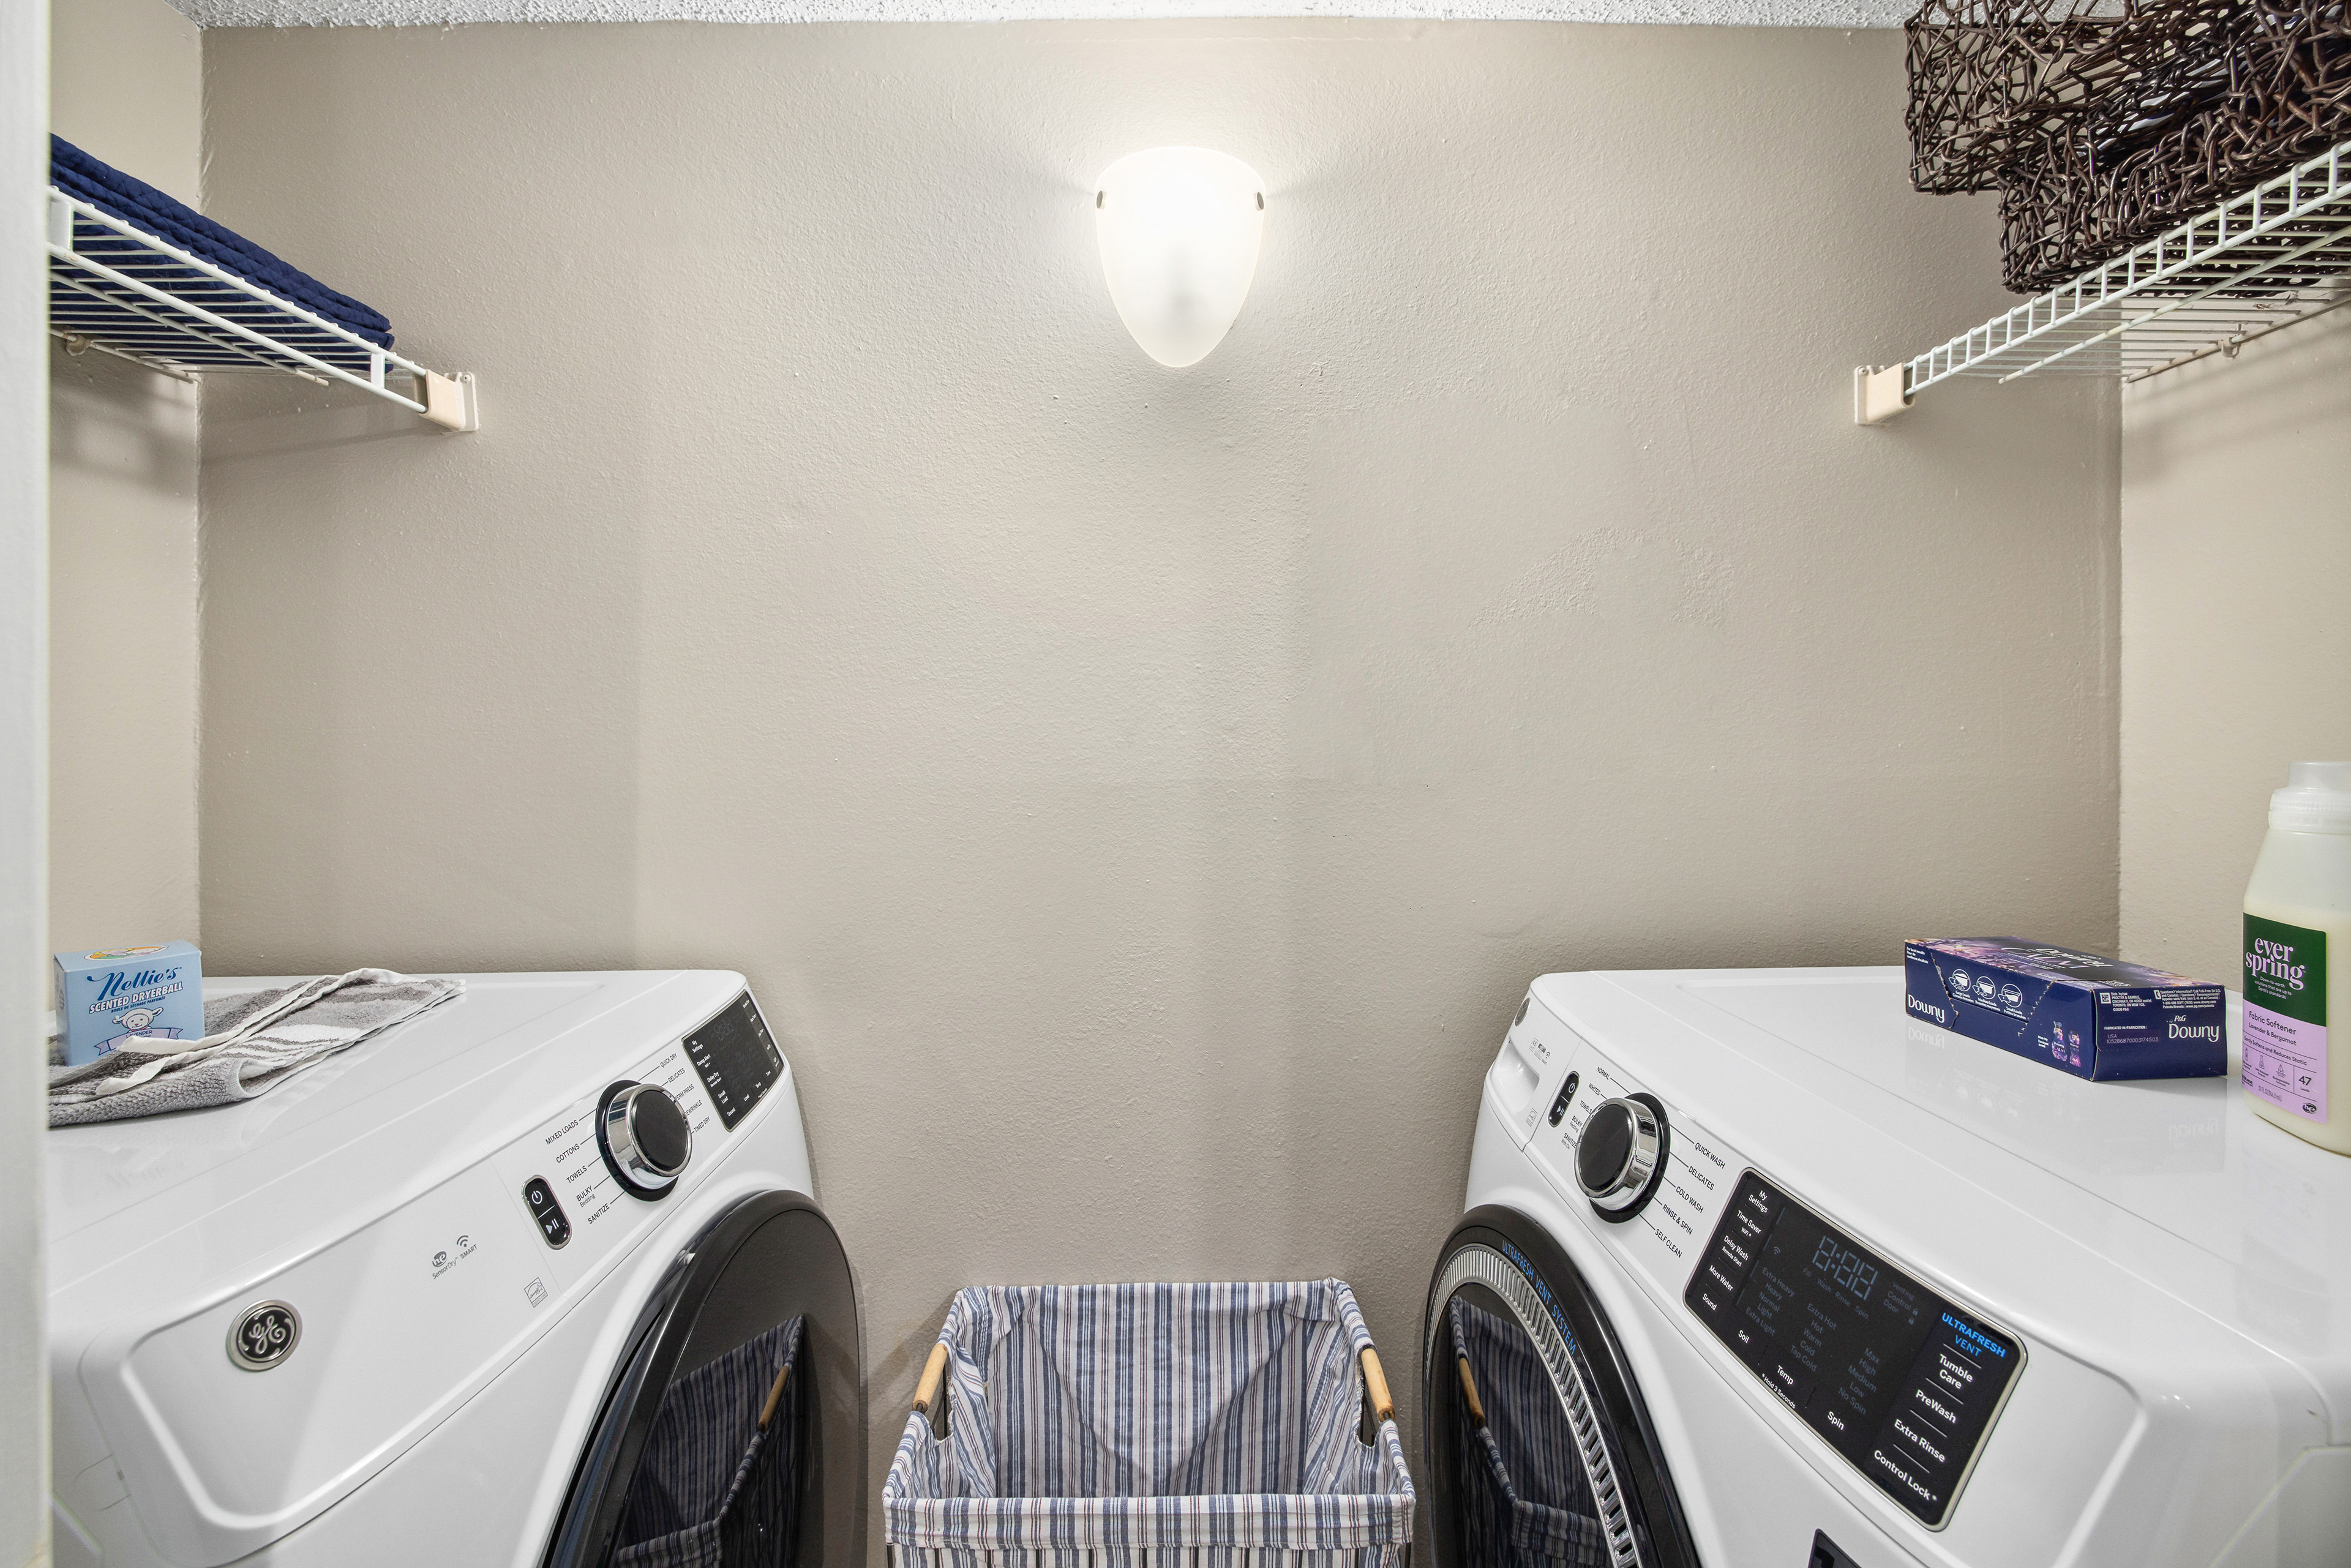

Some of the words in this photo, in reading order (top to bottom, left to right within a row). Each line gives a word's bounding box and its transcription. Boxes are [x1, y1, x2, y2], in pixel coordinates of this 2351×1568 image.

[2254, 937, 2294, 962] ever
[2246, 951, 2306, 990] spring
[86, 967, 179, 1001] Nellie's
[89, 996, 130, 1014] SCENTED
[132, 981, 183, 1003] DRYERBALL
[1908, 994, 1944, 1023] Downy
[2169, 1023, 2219, 1042] Downy
[2249, 1010, 2265, 1024] Fabric
[2267, 1018, 2297, 1035] Softener
[2249, 1022, 2266, 1034] Lavender
[2271, 1032, 2297, 1046] Bergamot
[660, 1057, 670, 1068] QUICK
[2252, 1040, 2265, 1050] Softens
[2273, 1049, 2292, 1060] Reduces
[2292, 1056, 2308, 1066] Static
[668, 1068, 685, 1083] DELICATES
[1596, 1066, 1610, 1080] NORMAL
[2298, 1076, 2312, 1086] 47
[683, 1084, 694, 1095] PRESS
[1588, 1082, 1601, 1096] WHITES
[1580, 1100, 1592, 1114] TOWELS
[694, 1120, 705, 1133] TIMED
[1572, 1115, 1583, 1128] BULKY
[545, 1129, 563, 1145] MIXED
[561, 1120, 579, 1135] LOADS
[1563, 1133, 1577, 1149] SANITIZE
[556, 1144, 580, 1163] COTTONS
[1695, 1142, 1711, 1158] QUICK
[1710, 1153, 1726, 1169] WASH
[566, 1166, 587, 1184] TOWELS
[1688, 1166, 1714, 1191] DELICATES
[576, 1185, 593, 1202] BULKY
[580, 1193, 596, 1208] Bedding
[1676, 1186, 1689, 1201] COLD
[1689, 1196, 1704, 1214] WASH
[1759, 1190, 1768, 1201] My
[588, 1203, 610, 1225] SANITIZE
[1749, 1195, 1768, 1214] Settings
[1662, 1204, 1678, 1220] RINSE
[1680, 1220, 1693, 1235] SPIN
[1737, 1210, 1748, 1223] Time
[1748, 1220, 1761, 1234] Saver
[460, 1244, 478, 1259] SMART
[1655, 1228, 1667, 1242] SELF
[1666, 1239, 1682, 1258] CLEAN
[1723, 1235, 1737, 1250] Delay
[1736, 1245, 1749, 1261] Wash
[1722, 1246, 1734, 1259] Remote
[1733, 1256, 1742, 1267] Start
[1709, 1265, 1720, 1279] More
[1719, 1275, 1734, 1292] Water
[1762, 1267, 1776, 1283] Extra
[1777, 1279, 1795, 1297] Heavy
[1817, 1278, 1832, 1292] Wash
[1502, 1240, 1534, 1281] ULTRAFRESH
[1536, 1275, 1551, 1305] VENT
[1552, 1305, 1577, 1354] SYSTEM
[1766, 1283, 1782, 1300] Heavy
[1835, 1291, 1851, 1307] Rinse
[1888, 1291, 1911, 1311] Control
[1892, 1281, 1914, 1302] Venting
[1703, 1293, 1717, 1311] Sound
[1758, 1303, 1772, 1319] Light
[1759, 1292, 1780, 1312] Normal
[1854, 1305, 1869, 1319] Spin
[1883, 1299, 1899, 1313] Door
[1746, 1307, 1760, 1323] Extra
[1760, 1319, 1775, 1336] Light
[1807, 1303, 1824, 1320] Extra
[1824, 1316, 1837, 1330] Hot
[1738, 1330, 1749, 1343] Soil
[1810, 1320, 1823, 1334] Hot
[1941, 1313, 2007, 1358] ULTRAFRESH
[1804, 1328, 1821, 1347] Warm
[1955, 1335, 1982, 1357] VENT
[1800, 1340, 1815, 1356] Cold
[1864, 1348, 1880, 1364] Max
[1791, 1345, 1801, 1359] Tap
[1802, 1356, 1817, 1372] Cold
[1859, 1358, 1876, 1376] High
[1940, 1354, 1973, 1382] Tumble
[1777, 1365, 1794, 1386] Temp
[1848, 1365, 1877, 1392] Medium
[1940, 1369, 1962, 1389] Care
[1764, 1376, 1774, 1389] Hold
[1777, 1389, 1796, 1409] Seconds
[1850, 1381, 1864, 1398] Low
[1839, 1387, 1849, 1400] No
[1850, 1397, 1866, 1415] Spin
[1916, 1389, 1957, 1424] PreWash
[1828, 1411, 1845, 1430] Spin
[1894, 1418, 1919, 1442] Extra
[1919, 1437, 1946, 1463] Rinse
[1874, 1450, 1908, 1482] Control
[1908, 1476, 1931, 1501] Lock
